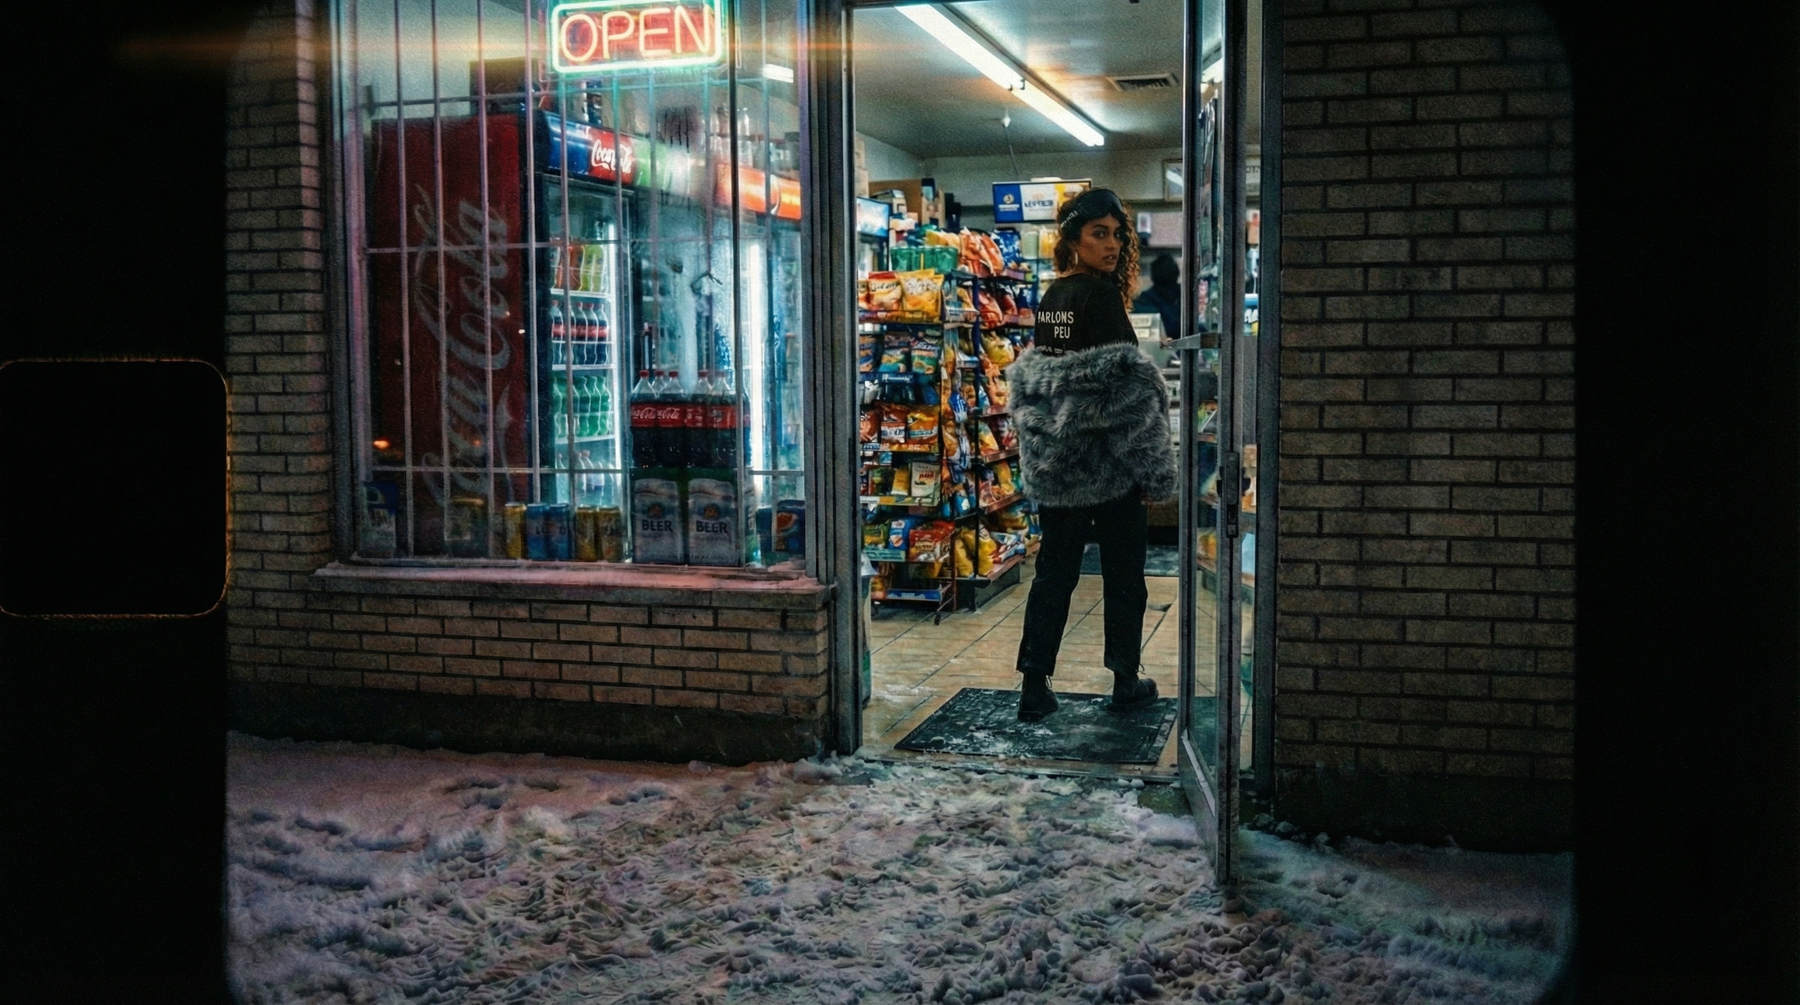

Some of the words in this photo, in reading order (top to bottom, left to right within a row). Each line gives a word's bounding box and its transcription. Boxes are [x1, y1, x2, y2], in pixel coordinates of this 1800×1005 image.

[560, 5, 710, 62] OPEN
[1054, 326, 1070, 339] PEU
[642, 520, 673, 532] BEER
[696, 521, 728, 533] BEER
